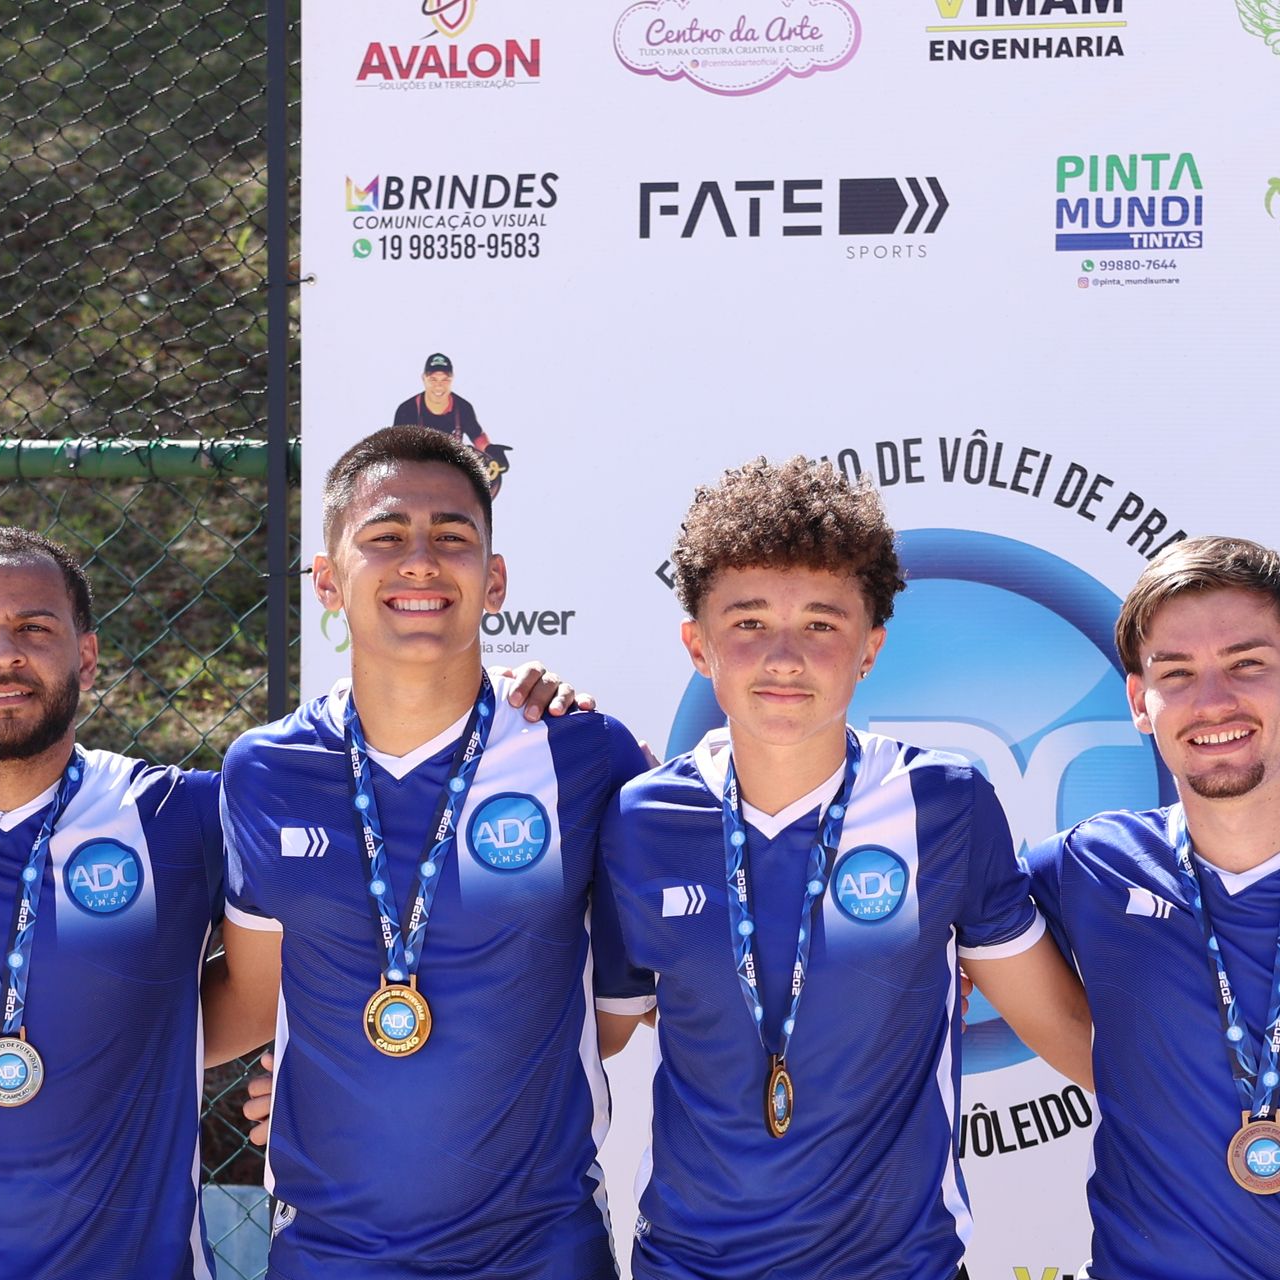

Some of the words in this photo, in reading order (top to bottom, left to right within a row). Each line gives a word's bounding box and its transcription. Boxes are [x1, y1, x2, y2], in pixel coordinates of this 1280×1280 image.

[645, 17, 725, 46] Centro
[730, 15, 759, 43] da
[765, 15, 823, 42] Arte
[356, 39, 540, 81] AVALON
[701, 58, 778, 68] @centrodaarteoficial
[929, 36, 1124, 61] ENGENHARIA
[378, 80, 426, 91] SOLUÇÕES
[429, 81, 442, 89] EM
[445, 79, 516, 90] TERCEIRIZAÇÃO
[1056, 152, 1203, 193] PINTA
[353, 212, 486, 231] COMUNICAÇÃO
[492, 213, 547, 227] VISUAL
[639, 179, 822, 239] FATE
[1056, 195, 1203, 229] MUNDI
[379, 234, 402, 260] 19
[410, 233, 540, 260] 98358-9583
[846, 245, 927, 259] SPORTS
[1129, 233, 1201, 248] TINTAS
[1100, 259, 1177, 271] 99880-7644
[875, 437, 926, 487] DE
[938, 428, 1053, 498] VÔLEI
[1053, 462, 1114, 522] DE
[1106, 491, 1188, 562] PRA
[481, 611, 576, 636] ower
[497, 642, 529, 653] solar
[463, 731, 480, 763] 2026
[435, 809, 453, 841] 2026
[474, 816, 545, 849] ADC
[364, 826, 376, 858] 2026
[71, 857, 137, 893] ADC
[736, 869, 747, 902] 2026
[838, 868, 904, 901] ADC
[18, 899, 30, 931] 2026
[409, 897, 424, 930] 2026
[381, 916, 394, 948] 2026
[744, 953, 757, 987] 2026
[1218, 971, 1232, 1005] 2026
[5, 988, 17, 1021] 2026
[382, 1013, 414, 1029] ADC
[376, 1036, 420, 1052] CAMPEÃO
